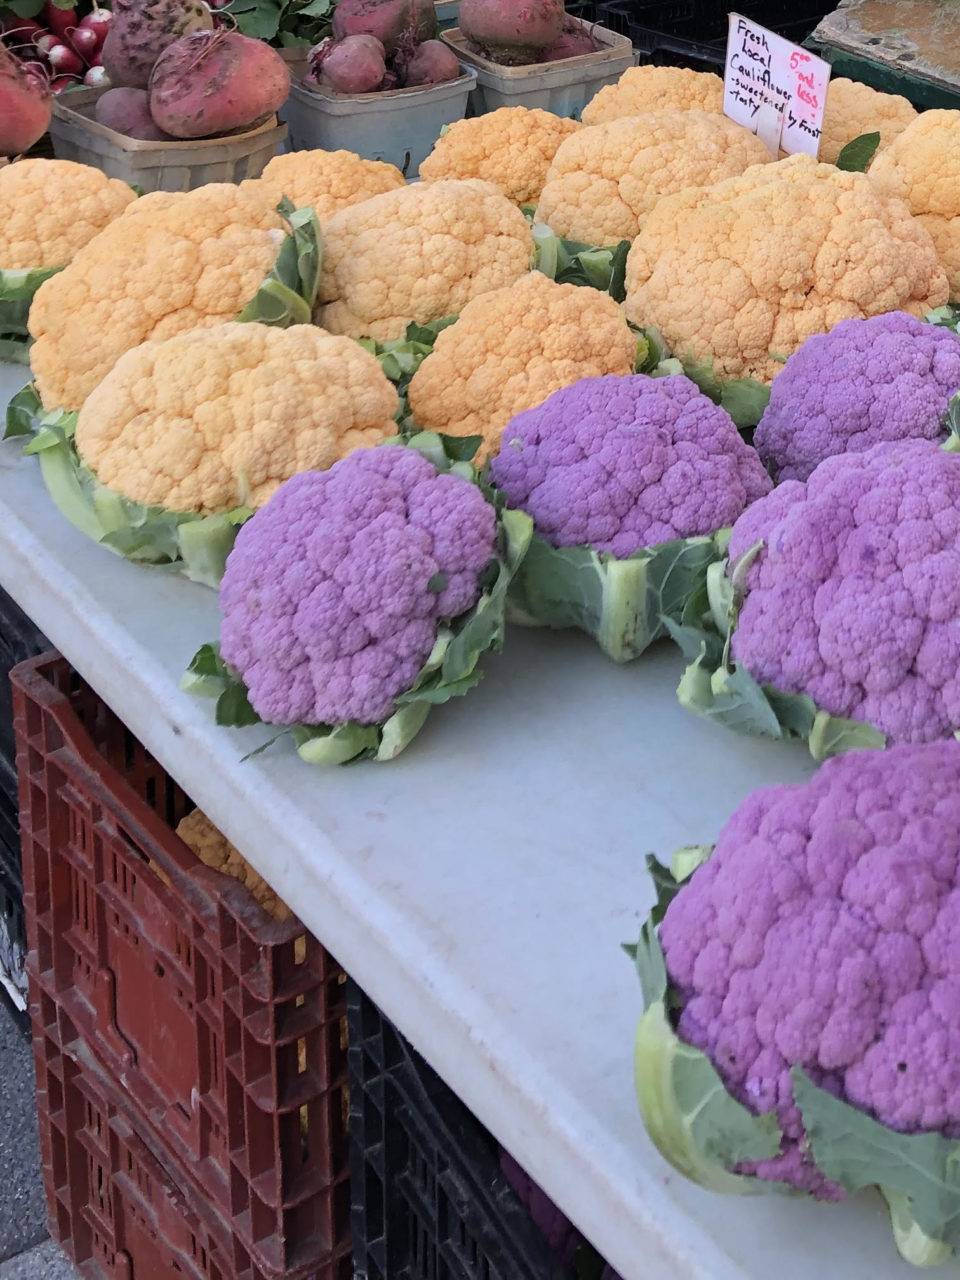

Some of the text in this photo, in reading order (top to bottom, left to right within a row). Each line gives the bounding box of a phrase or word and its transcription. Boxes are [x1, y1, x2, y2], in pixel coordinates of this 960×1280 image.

[737, 19, 769, 52] Fresh
[741, 38, 772, 69] Local
[730, 53, 792, 101] Cauliflower
[788, 110, 797, 129] by
